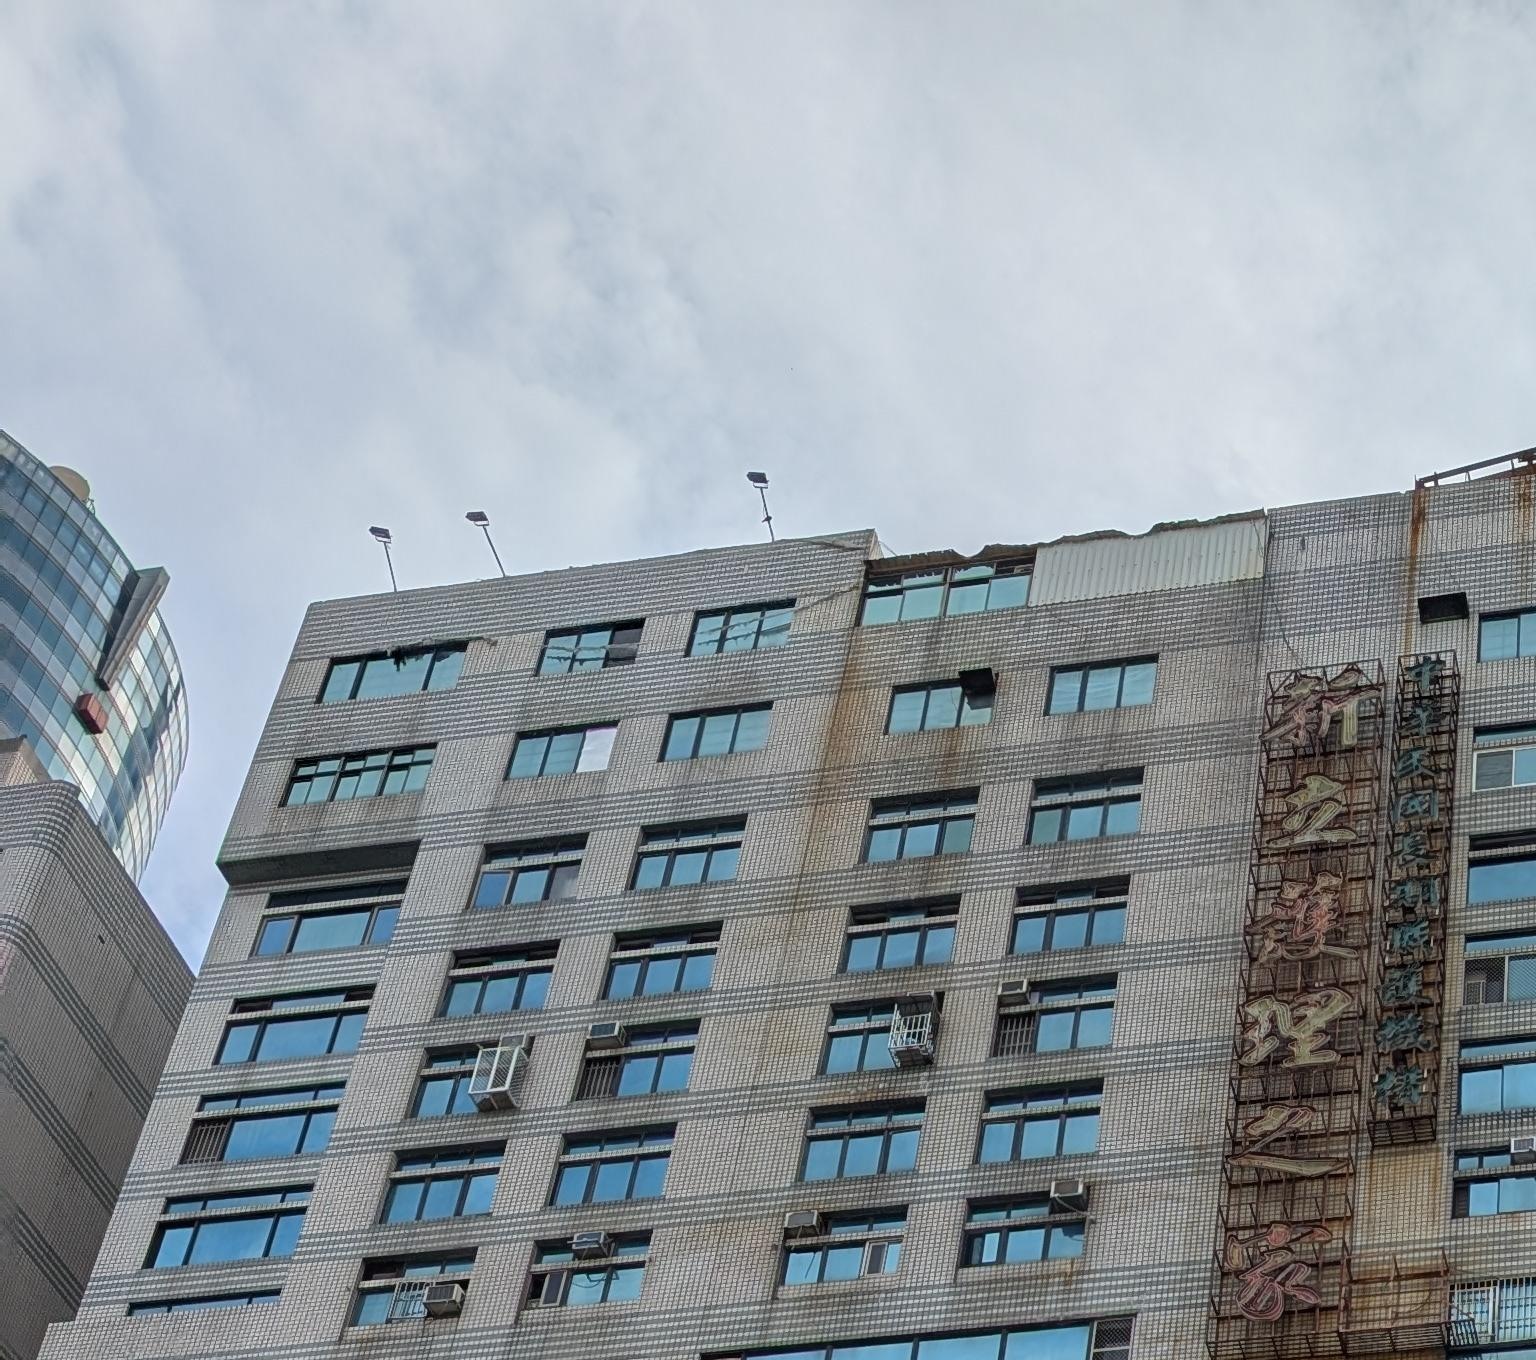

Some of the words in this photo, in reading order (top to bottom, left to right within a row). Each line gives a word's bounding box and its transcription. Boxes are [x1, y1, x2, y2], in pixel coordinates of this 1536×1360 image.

[1227, 668, 1382, 1322] 新立護理之家
